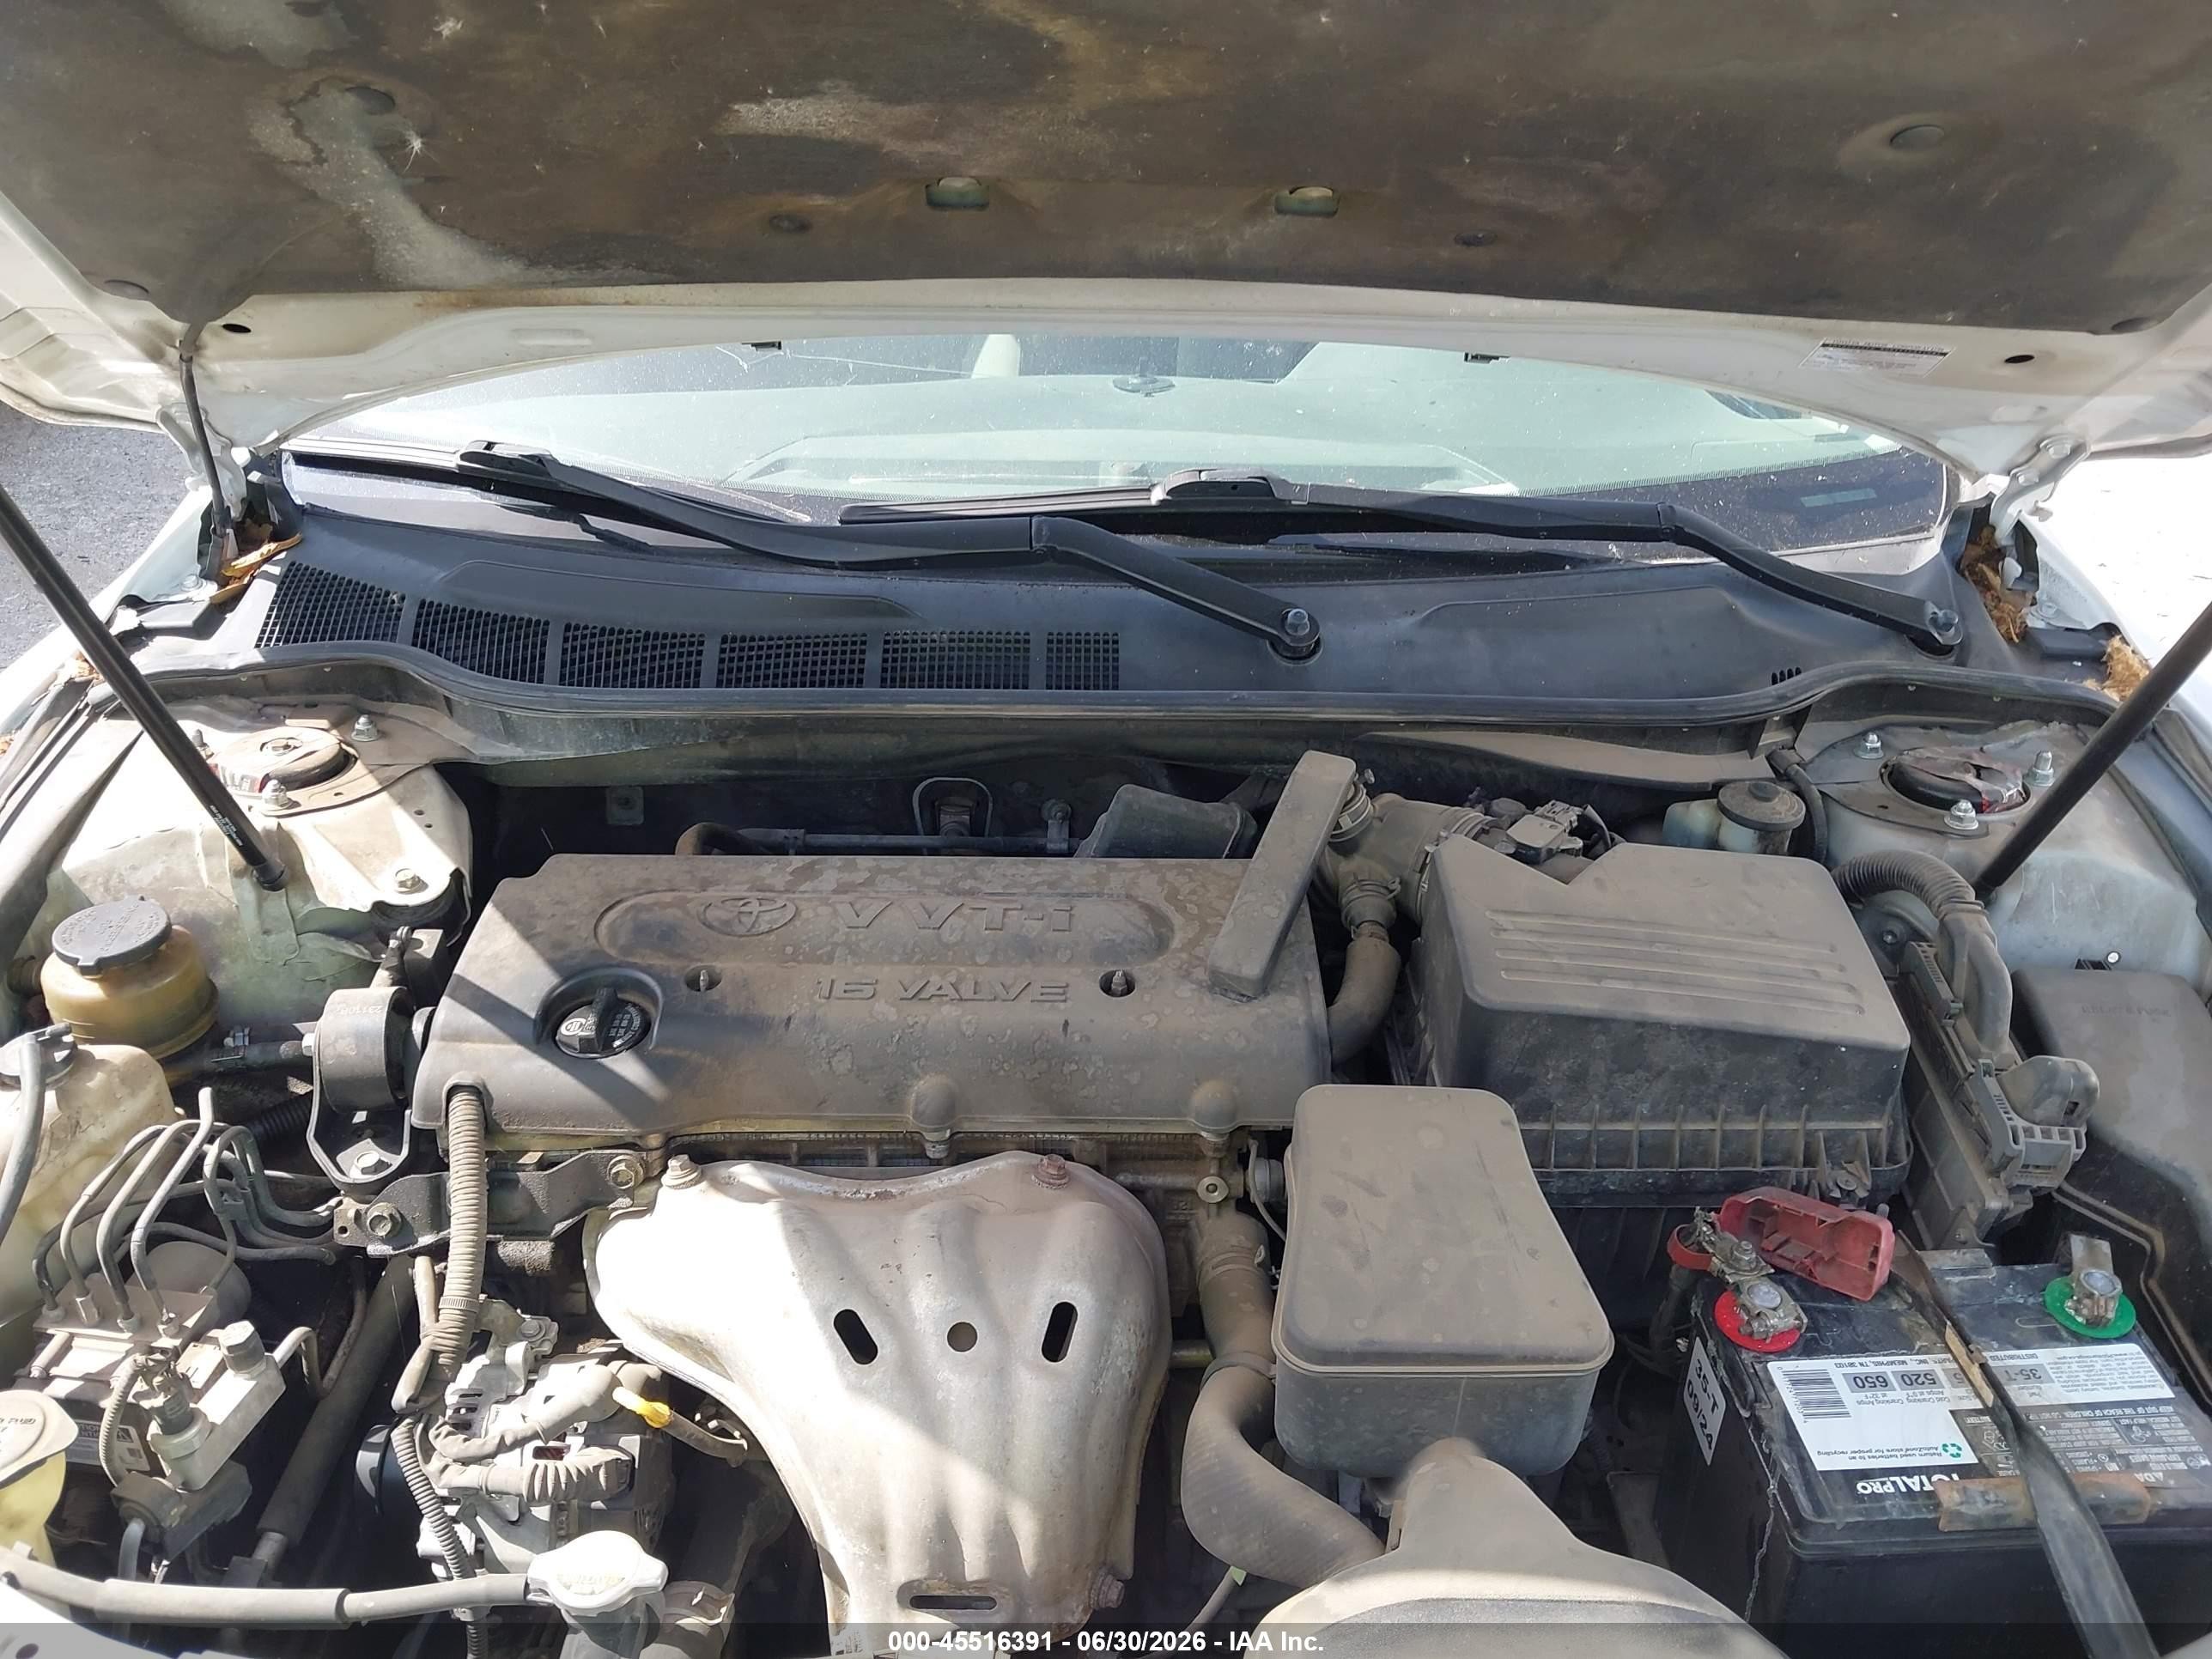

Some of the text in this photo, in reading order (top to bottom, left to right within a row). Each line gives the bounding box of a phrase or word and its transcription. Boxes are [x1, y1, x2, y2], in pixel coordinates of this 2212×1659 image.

[817, 978, 1069, 1003] 16 VALVE
[1853, 1376, 1888, 1389] 650
[1900, 1373, 1937, 1387] 520
[2004, 1368, 2042, 1381] 35-T
[1695, 1358, 1718, 1413] 35-T
[1686, 1378, 1713, 1450] 09/24
